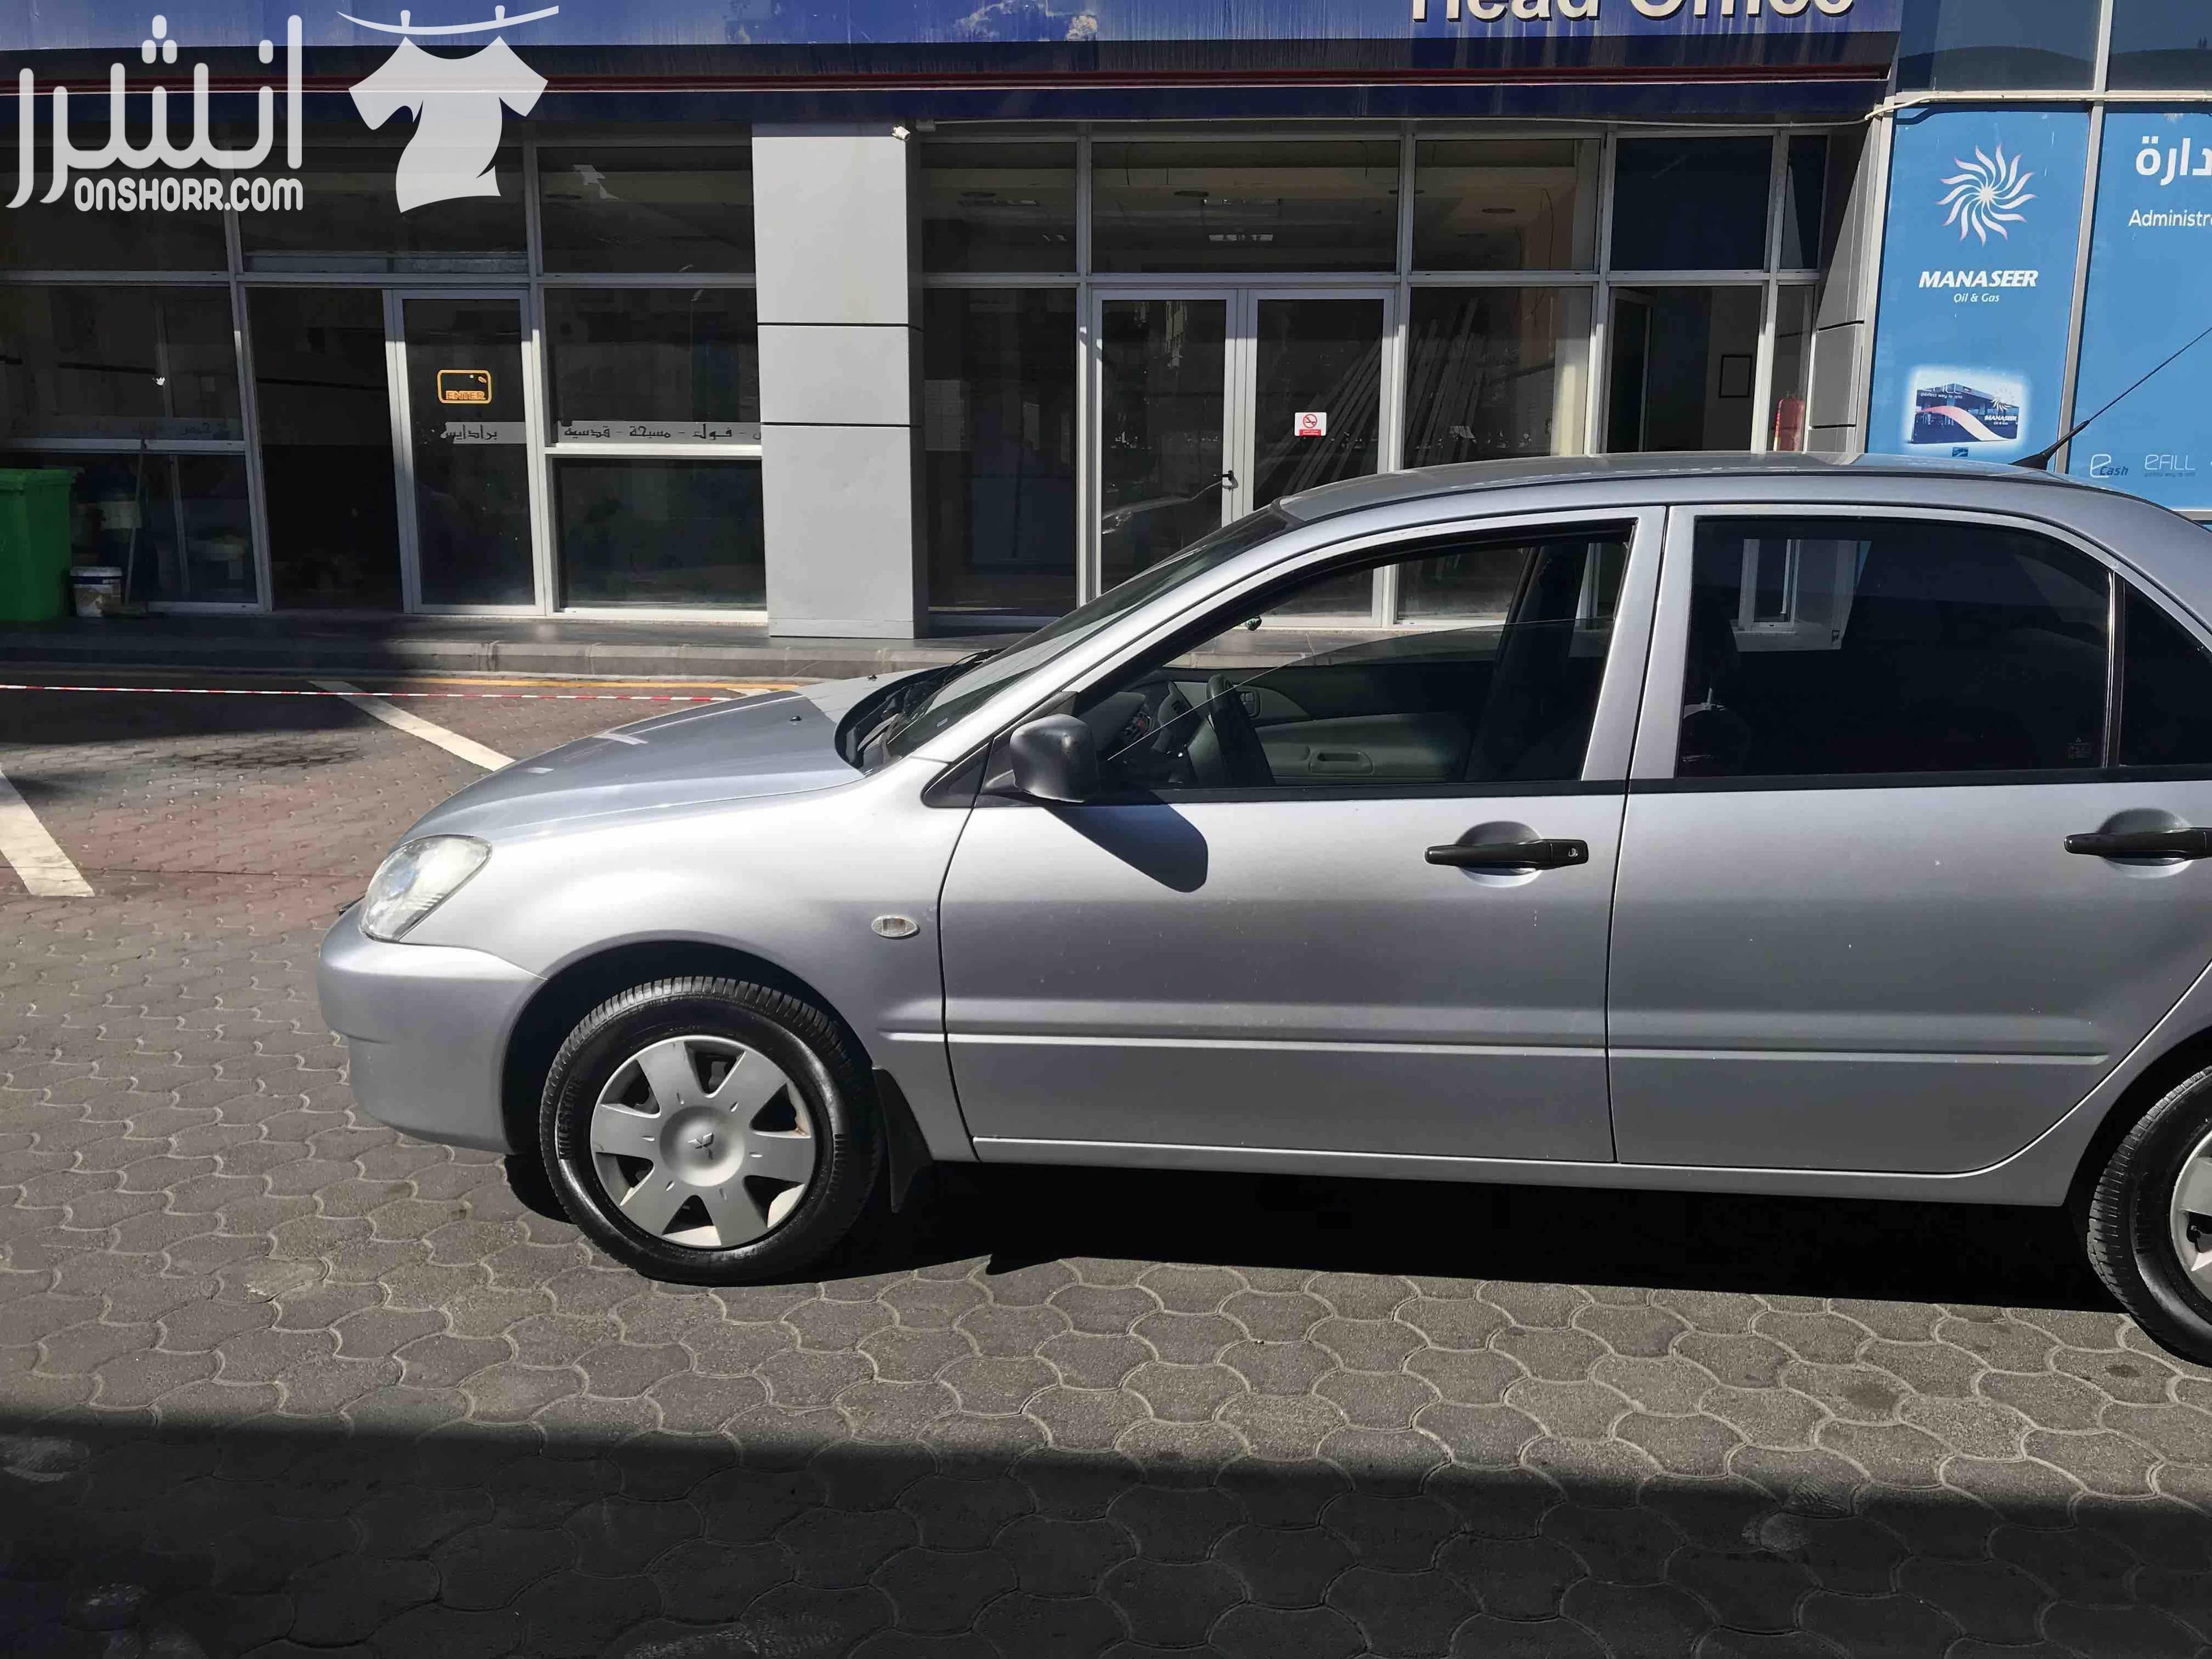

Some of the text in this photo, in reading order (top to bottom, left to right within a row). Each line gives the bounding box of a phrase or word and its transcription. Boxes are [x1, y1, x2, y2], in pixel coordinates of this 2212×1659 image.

[2128, 209, 2212, 227] Administr
[1919, 270, 2039, 288] MANASEER
[1954, 293, 1999, 303] Oil & Gas
[445, 390, 486, 400] ENTER
